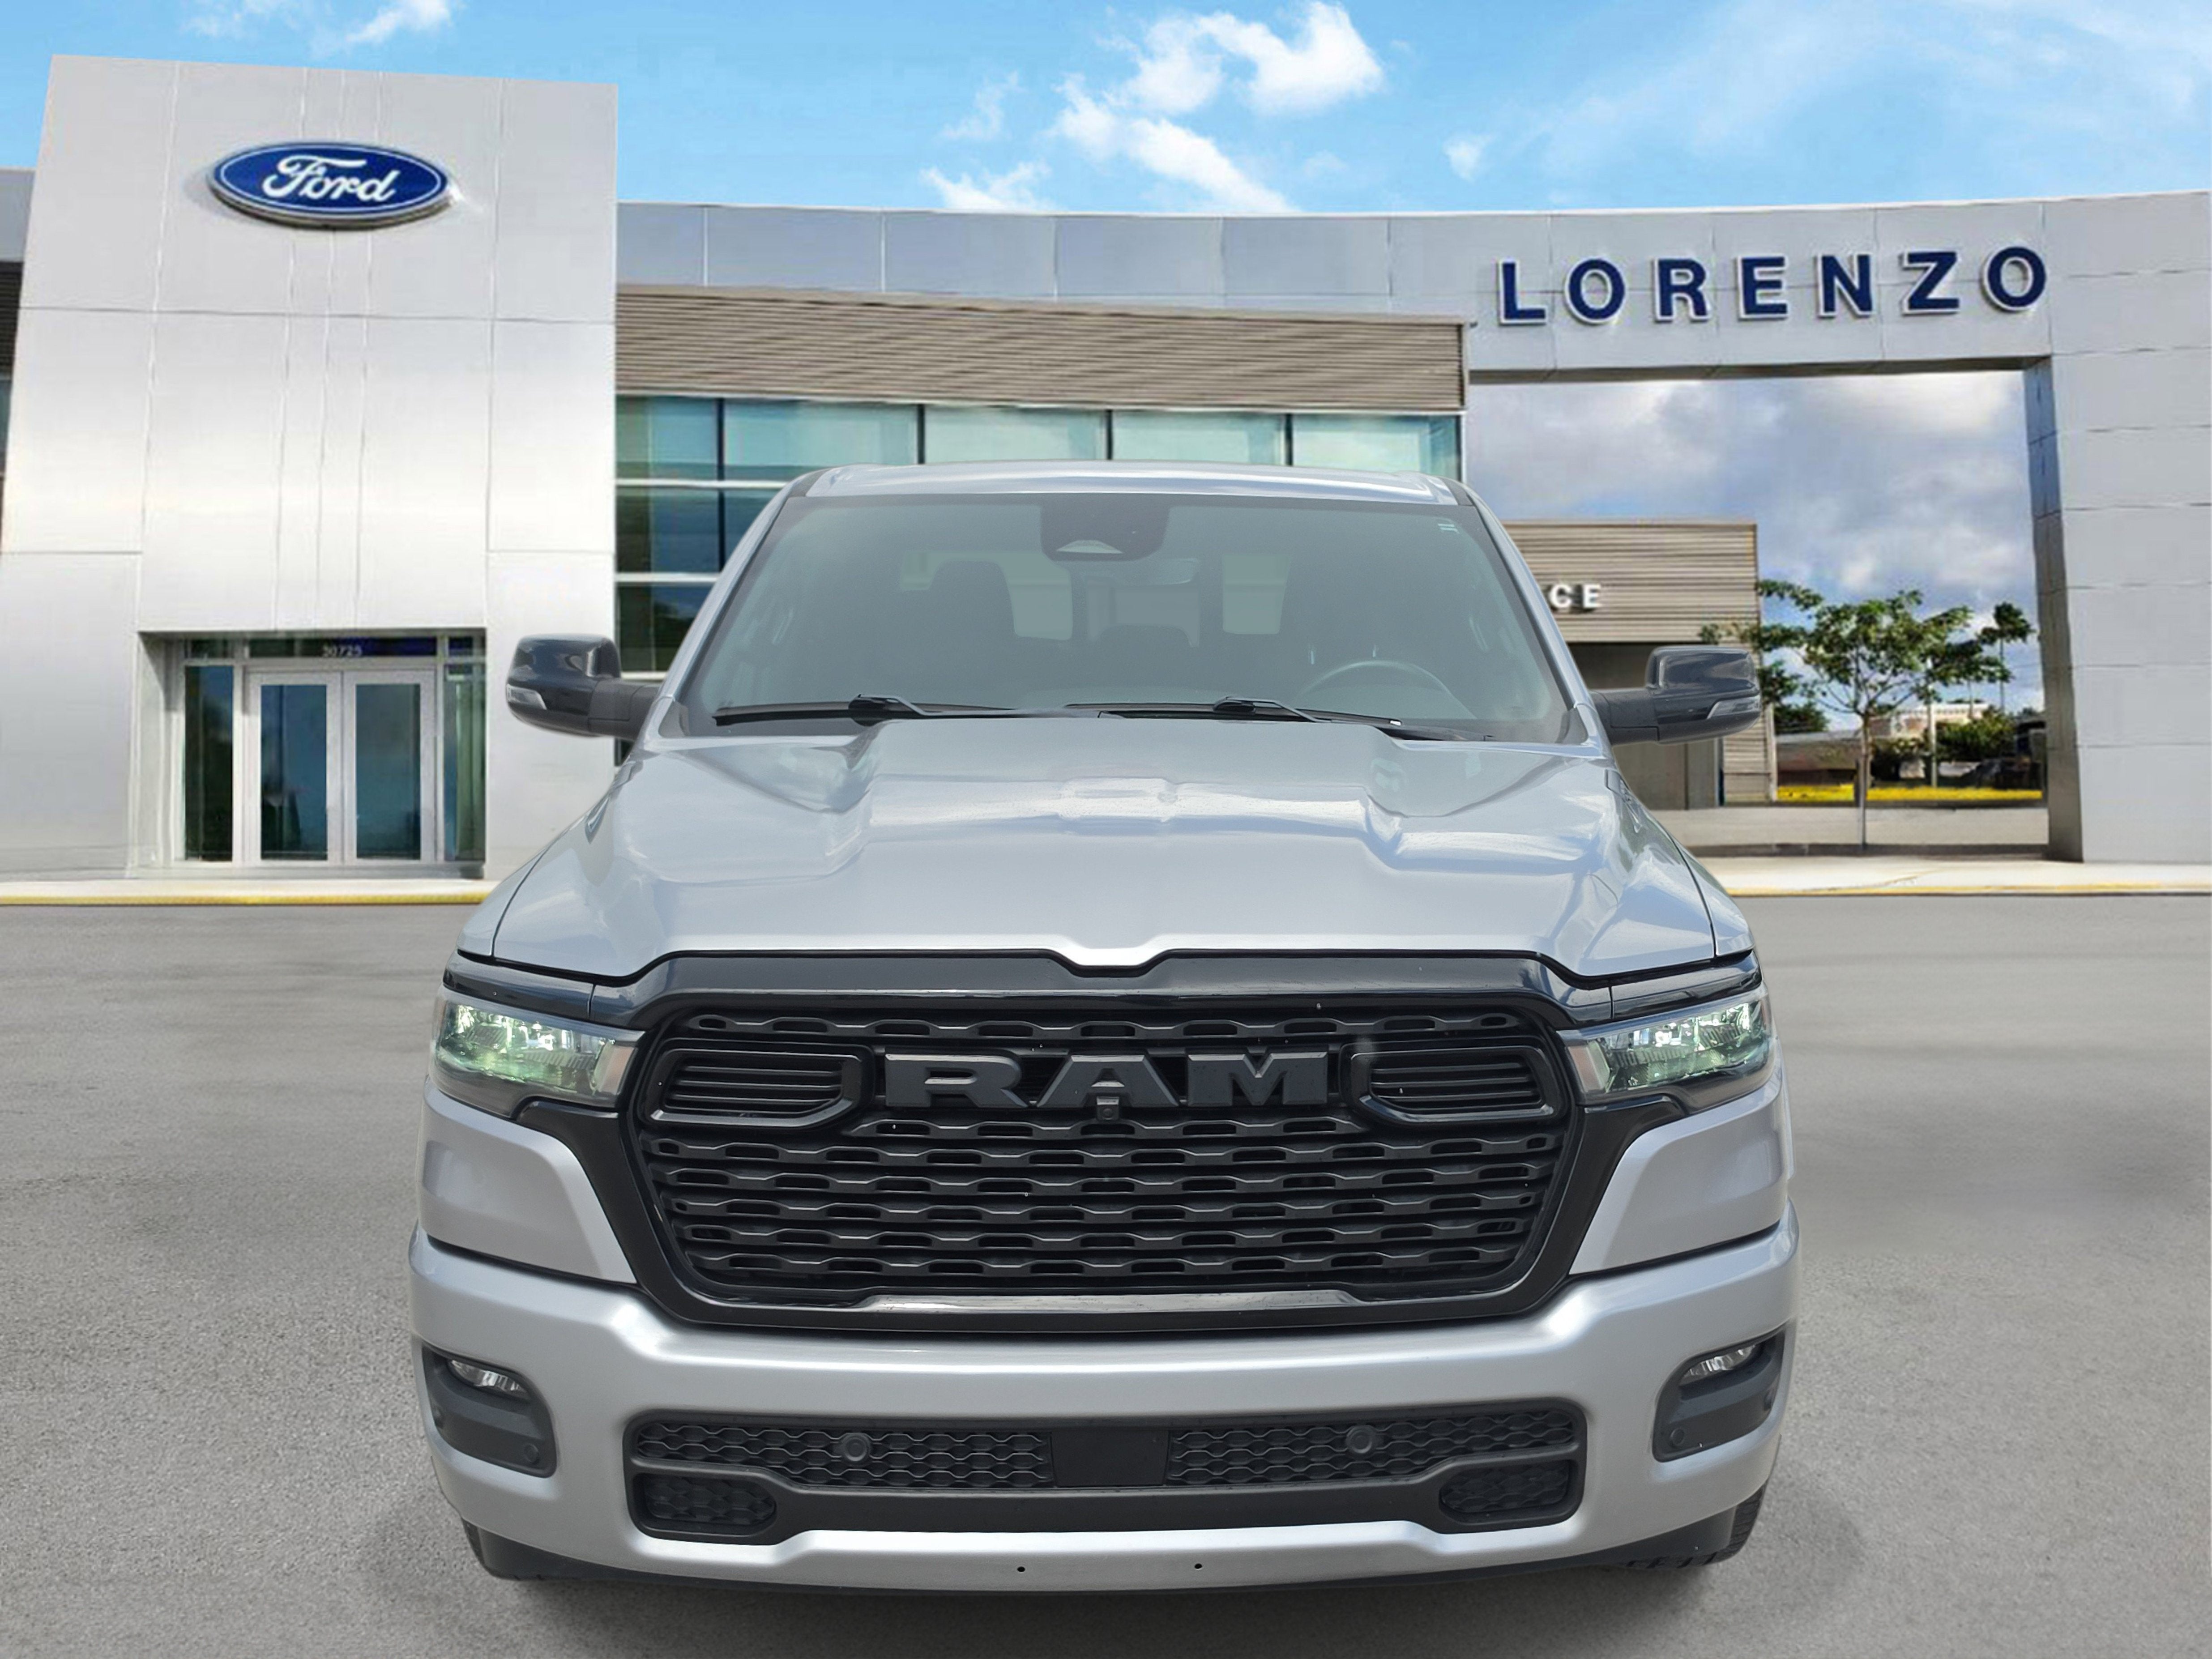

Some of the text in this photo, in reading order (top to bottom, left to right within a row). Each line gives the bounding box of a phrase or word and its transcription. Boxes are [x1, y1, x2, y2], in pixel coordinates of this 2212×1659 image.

[261, 154, 401, 202] Ford
[1498, 246, 2046, 324] LORENZO
[884, 1050, 1328, 1108] RAM
